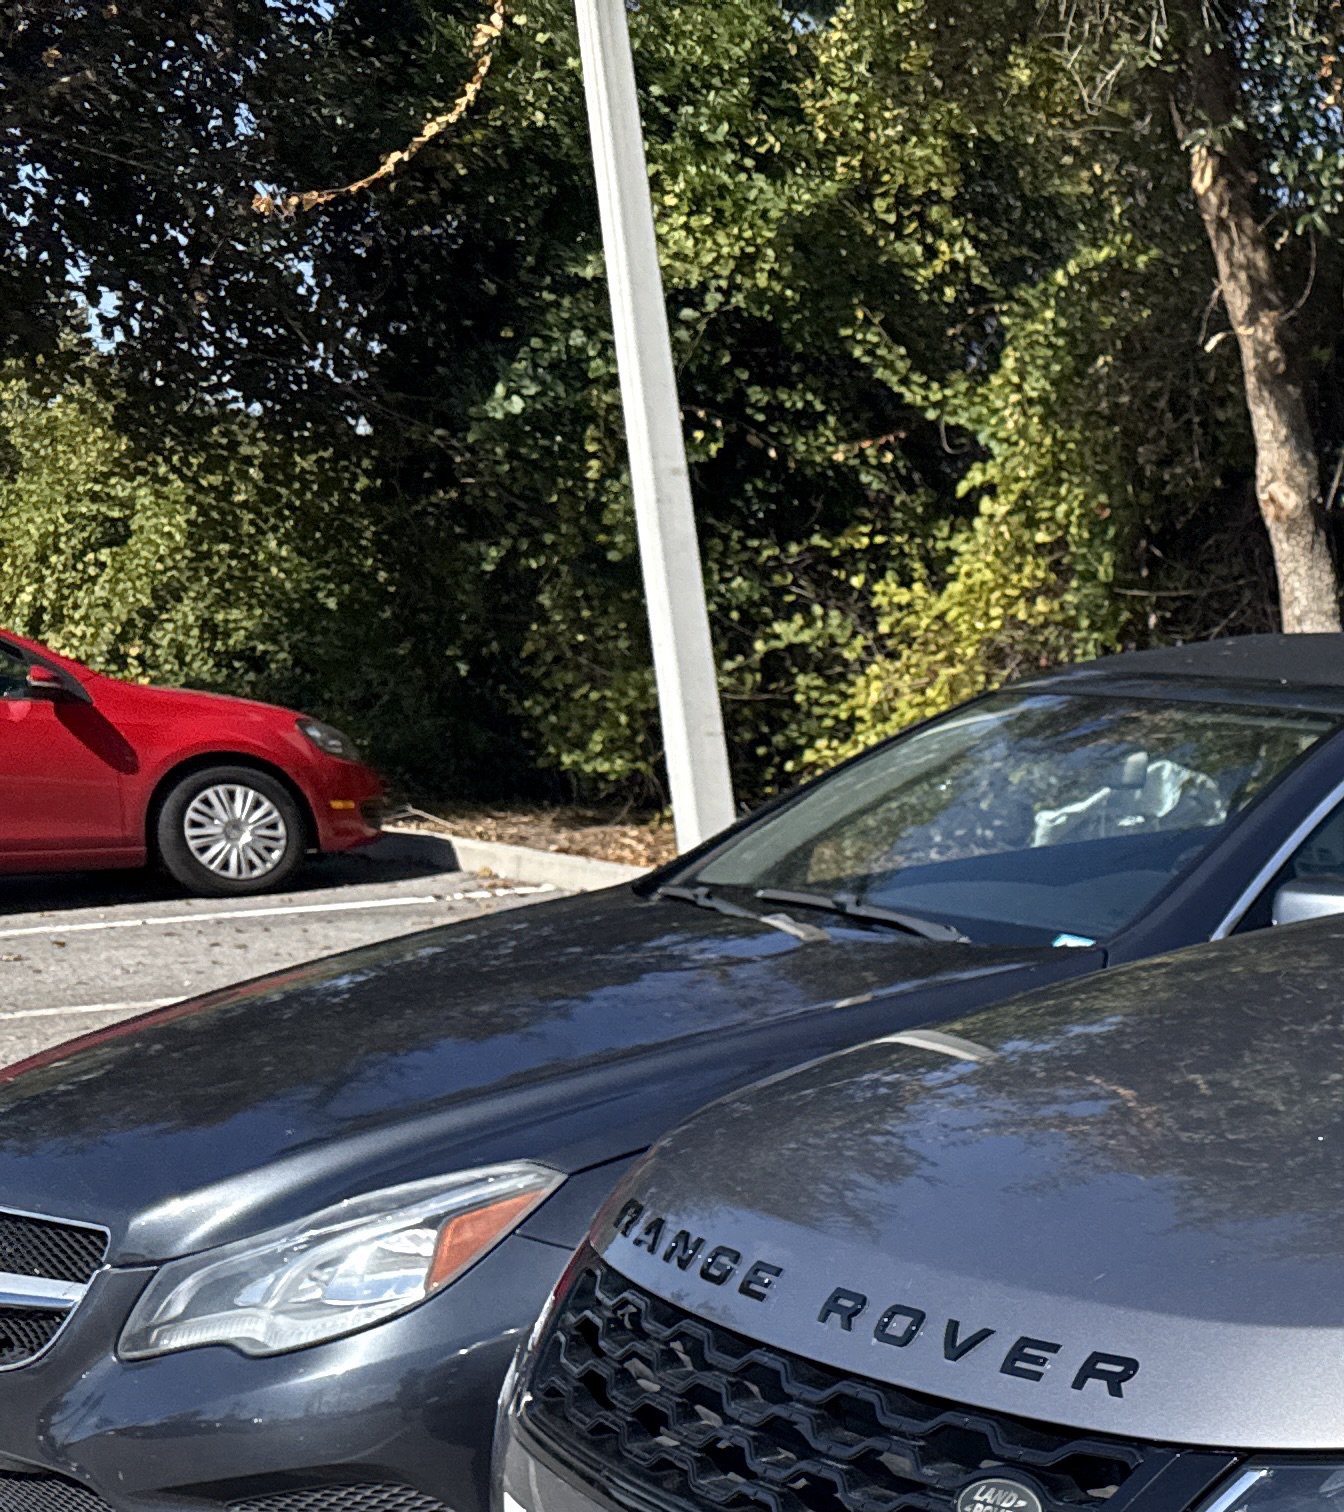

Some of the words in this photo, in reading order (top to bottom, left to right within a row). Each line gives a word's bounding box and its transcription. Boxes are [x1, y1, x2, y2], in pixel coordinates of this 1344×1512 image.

[613, 1197, 784, 1302] RANGE
[816, 1285, 1141, 1399] ROVER
[972, 1484, 1020, 1509] LAND
